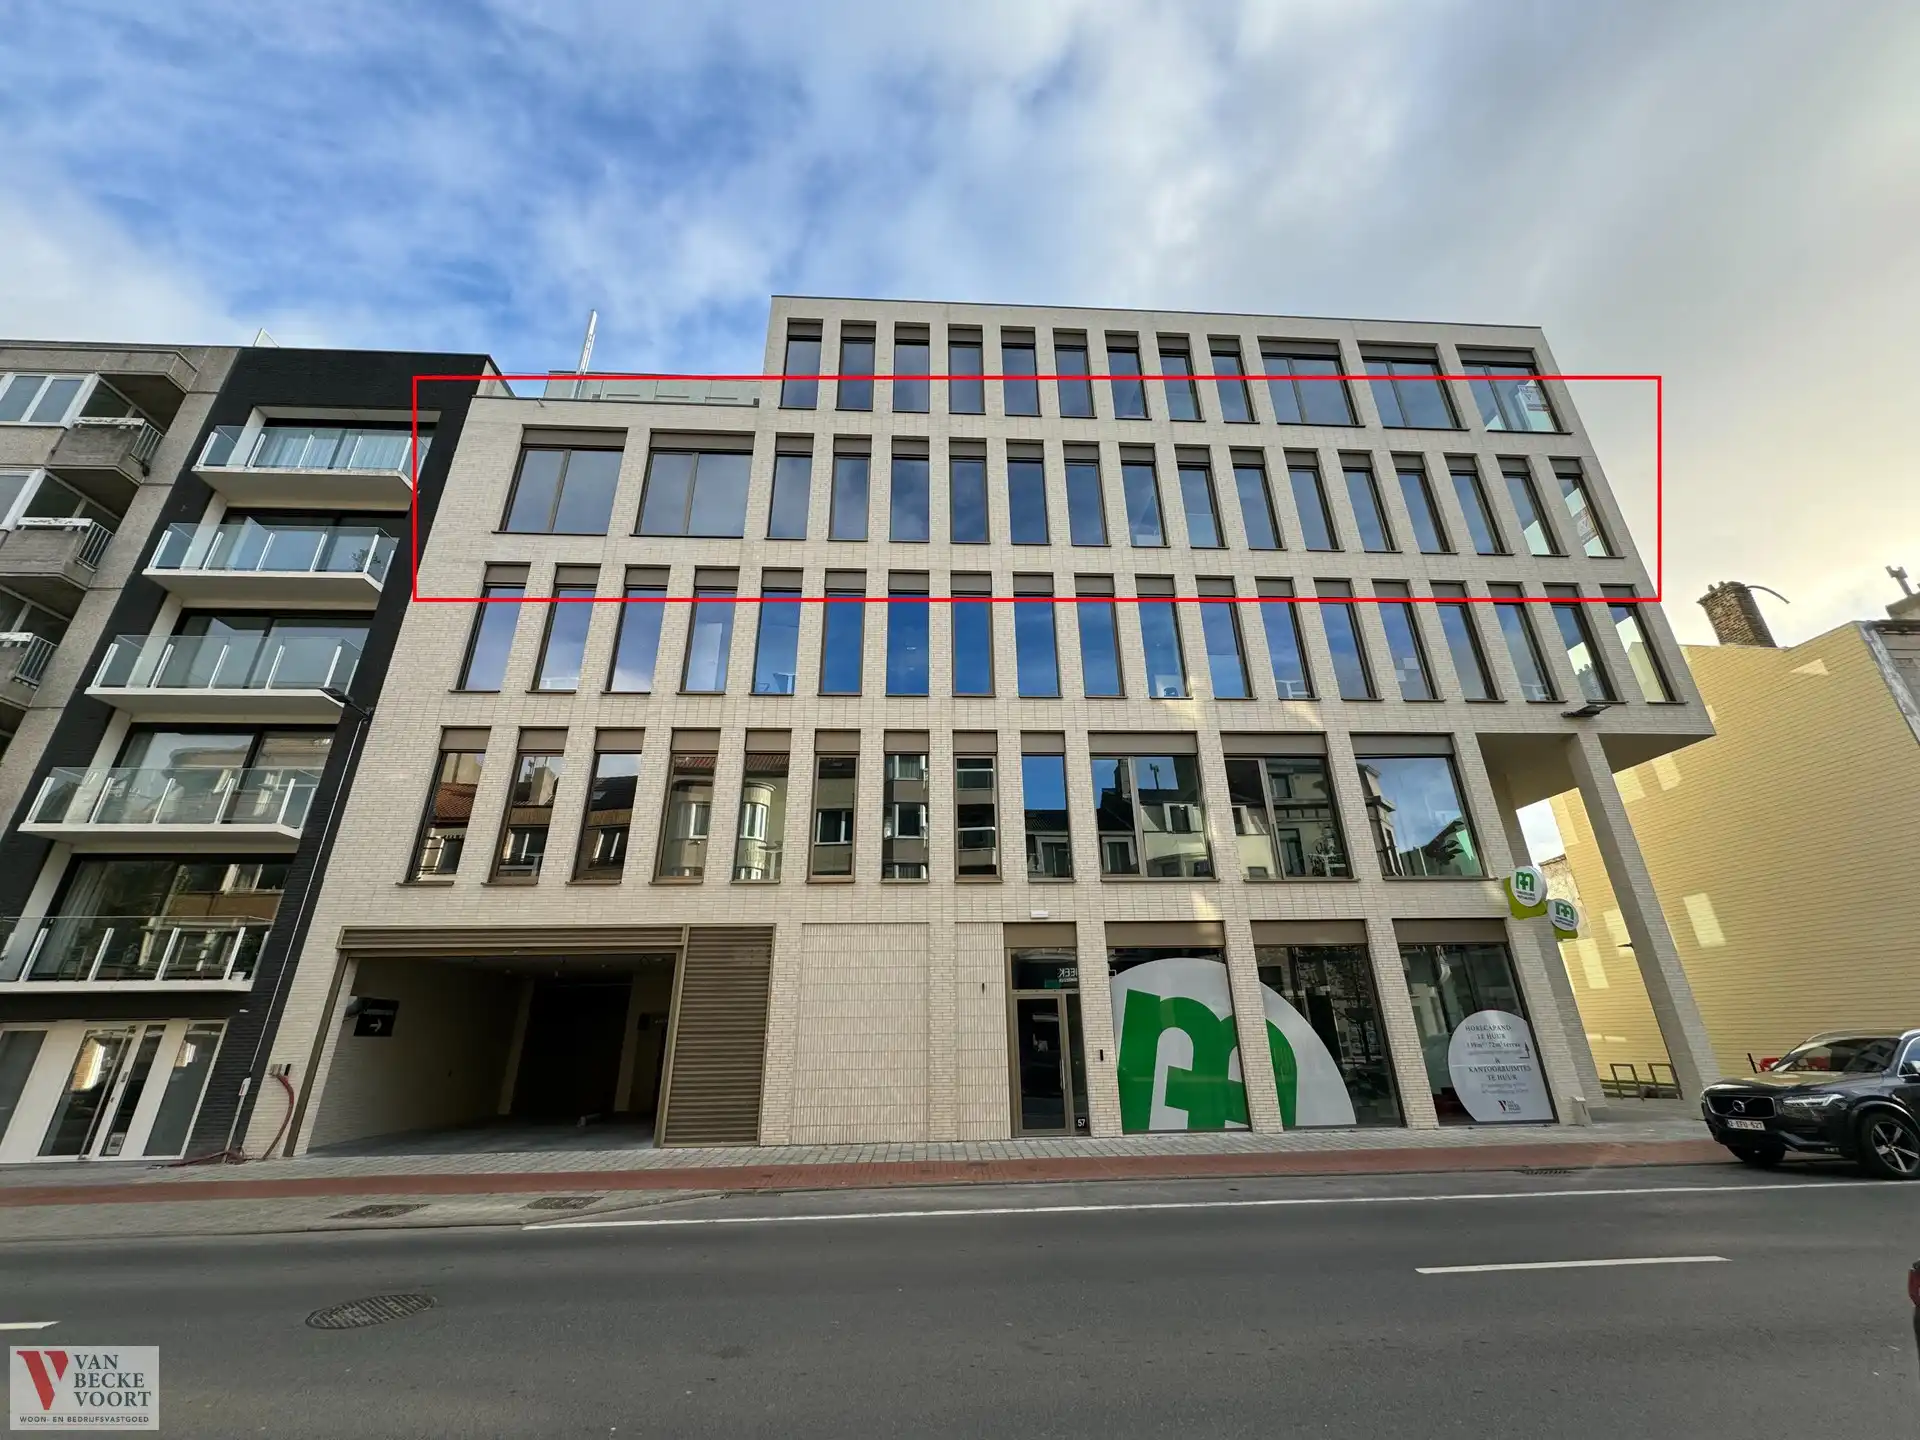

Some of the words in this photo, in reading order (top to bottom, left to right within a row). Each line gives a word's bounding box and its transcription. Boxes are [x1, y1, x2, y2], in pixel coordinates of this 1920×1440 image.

[1486, 1032, 1506, 1041] HUUR
[1496, 1073, 1518, 1081] HUUR
[1077, 1118, 1086, 1127] 57
